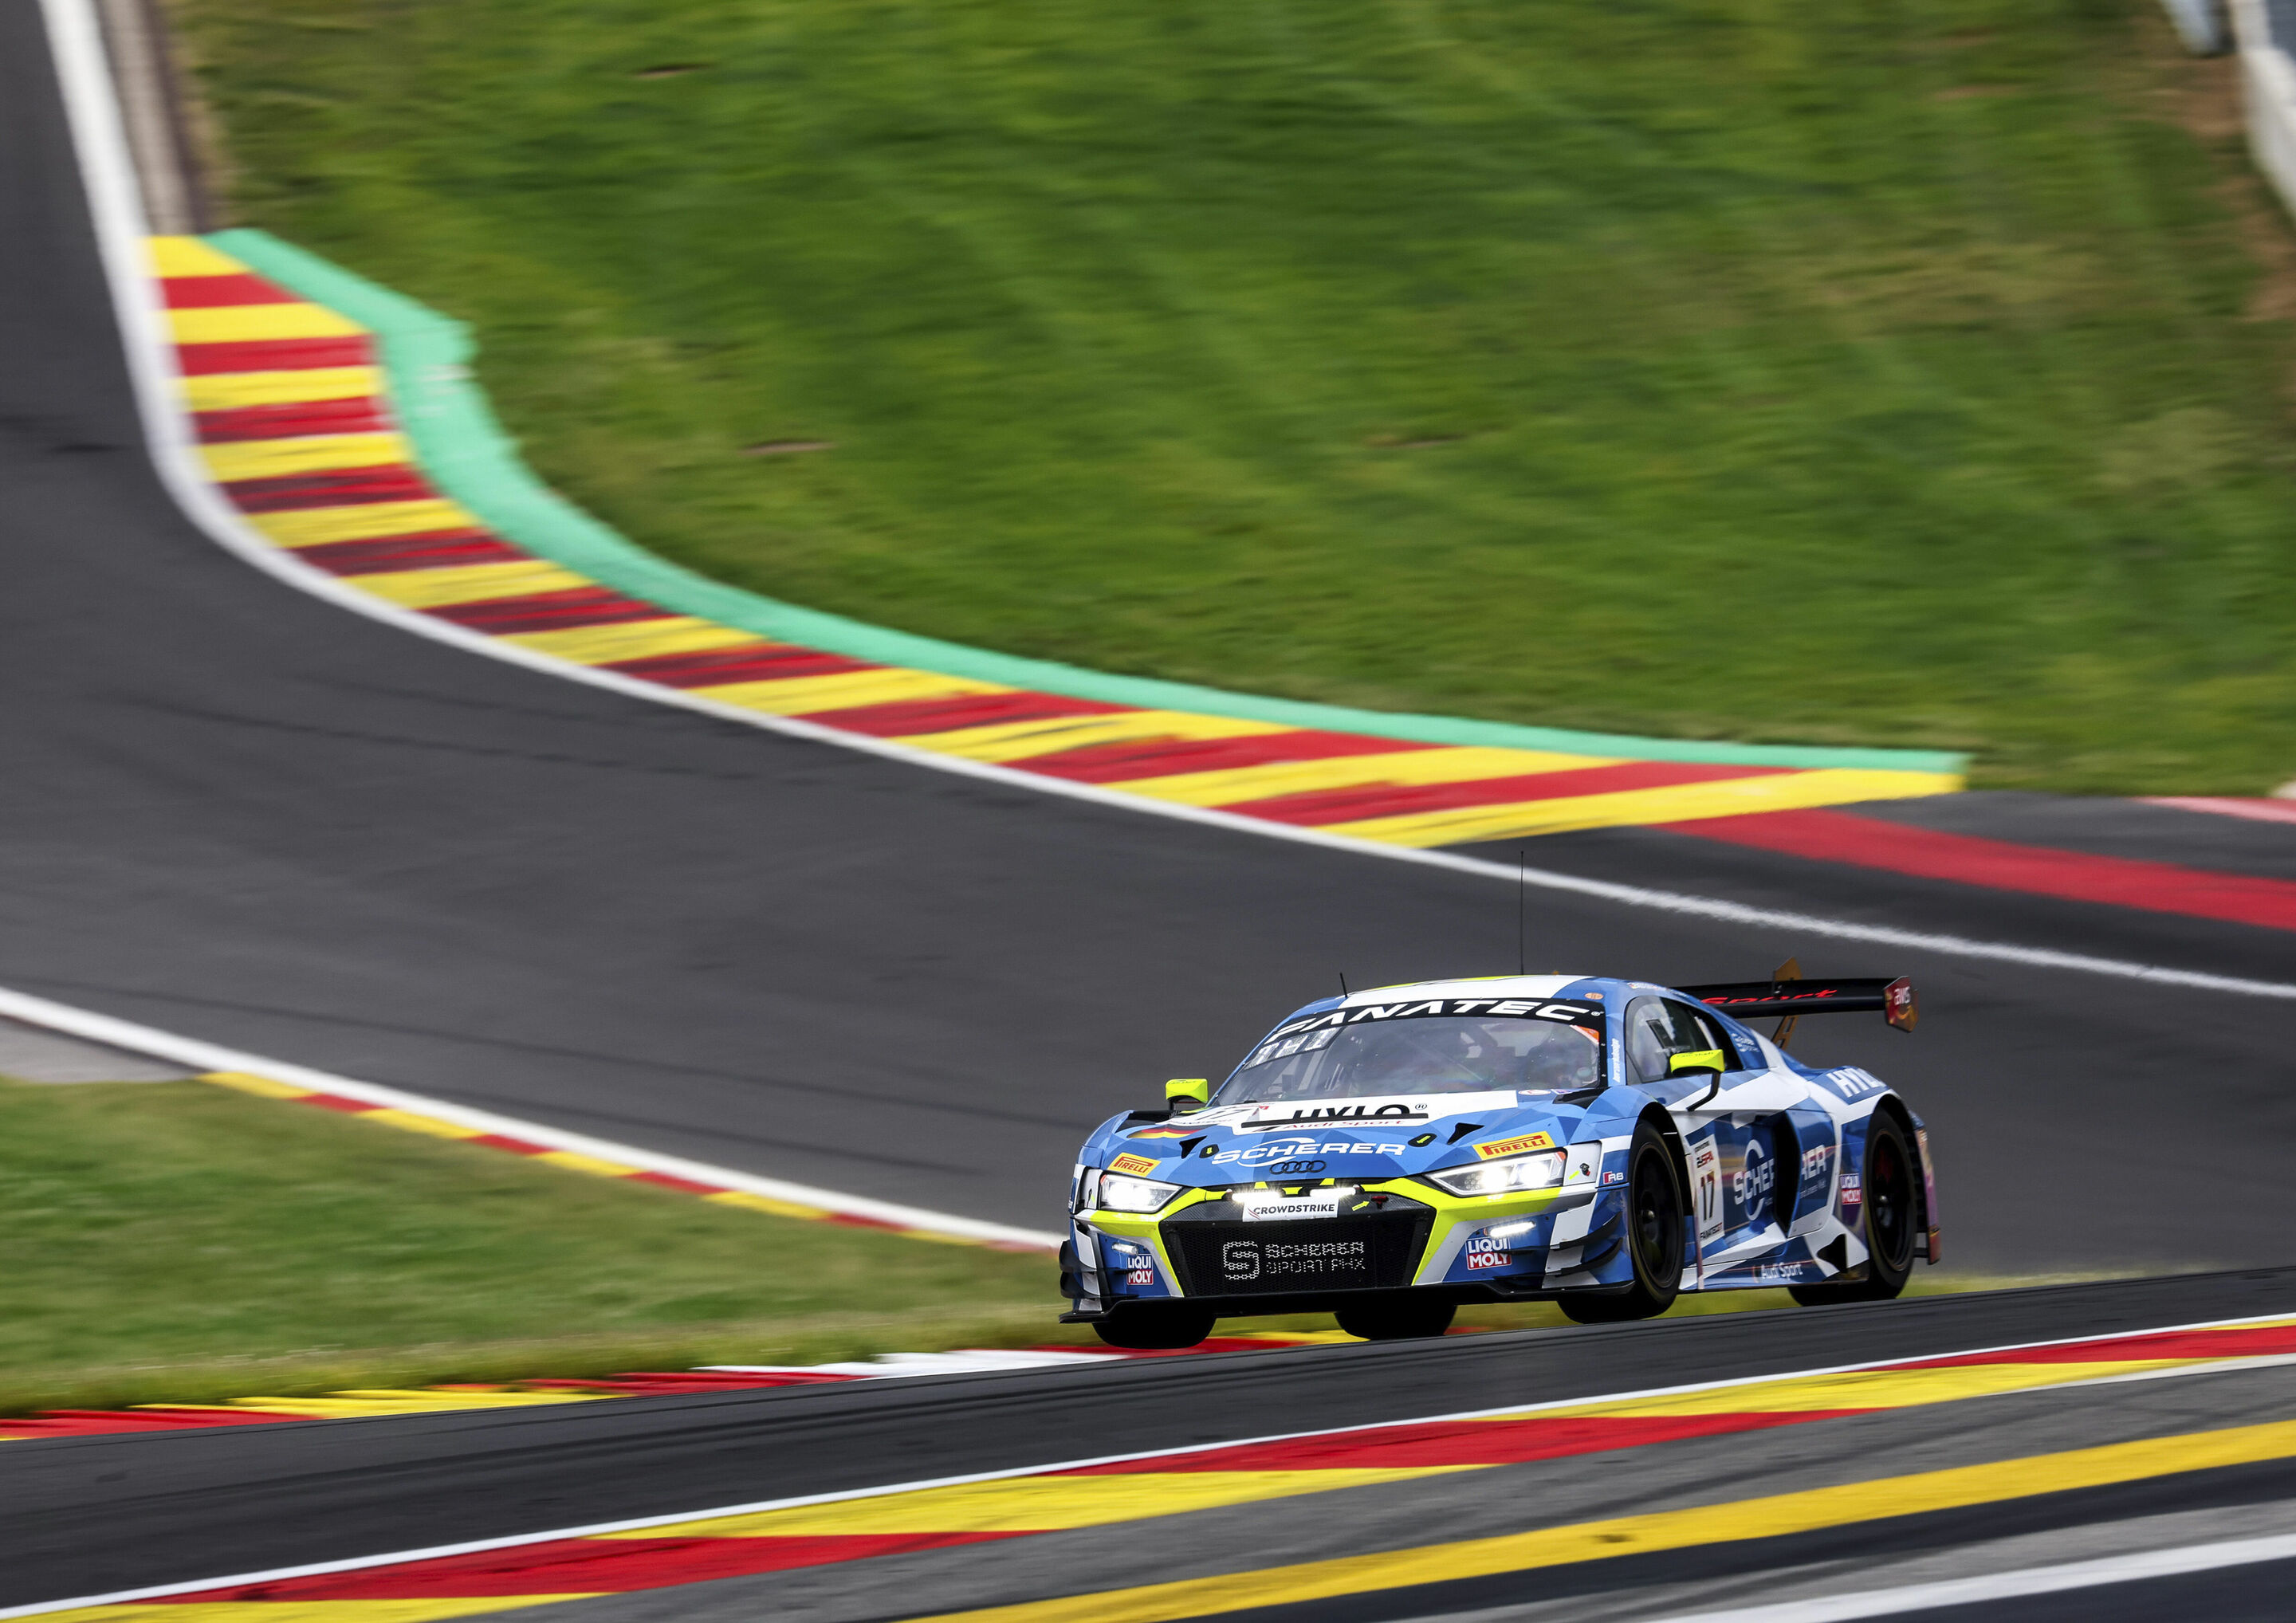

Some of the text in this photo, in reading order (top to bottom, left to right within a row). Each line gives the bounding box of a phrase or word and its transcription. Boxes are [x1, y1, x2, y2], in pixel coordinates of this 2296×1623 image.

[1894, 986, 1911, 1006] aws
[1264, 999, 1590, 1045] FANATEC
[1826, 1067, 1887, 1098] HYL
[1211, 1140, 1406, 1165] SCHERER
[1482, 1135, 1547, 1156] PIRELLI
[1114, 1157, 1154, 1173] PIRELLI
[1607, 1172, 1625, 1182] R8
[1700, 1171, 1716, 1221] 17
[1253, 1204, 1335, 1215] CROWDSTRIKE
[1467, 1238, 1508, 1255] LIQUI
[1127, 1255, 1152, 1269] LIQUI
[1468, 1252, 1512, 1268] MOLY
[1127, 1270, 1153, 1284] MOLY
